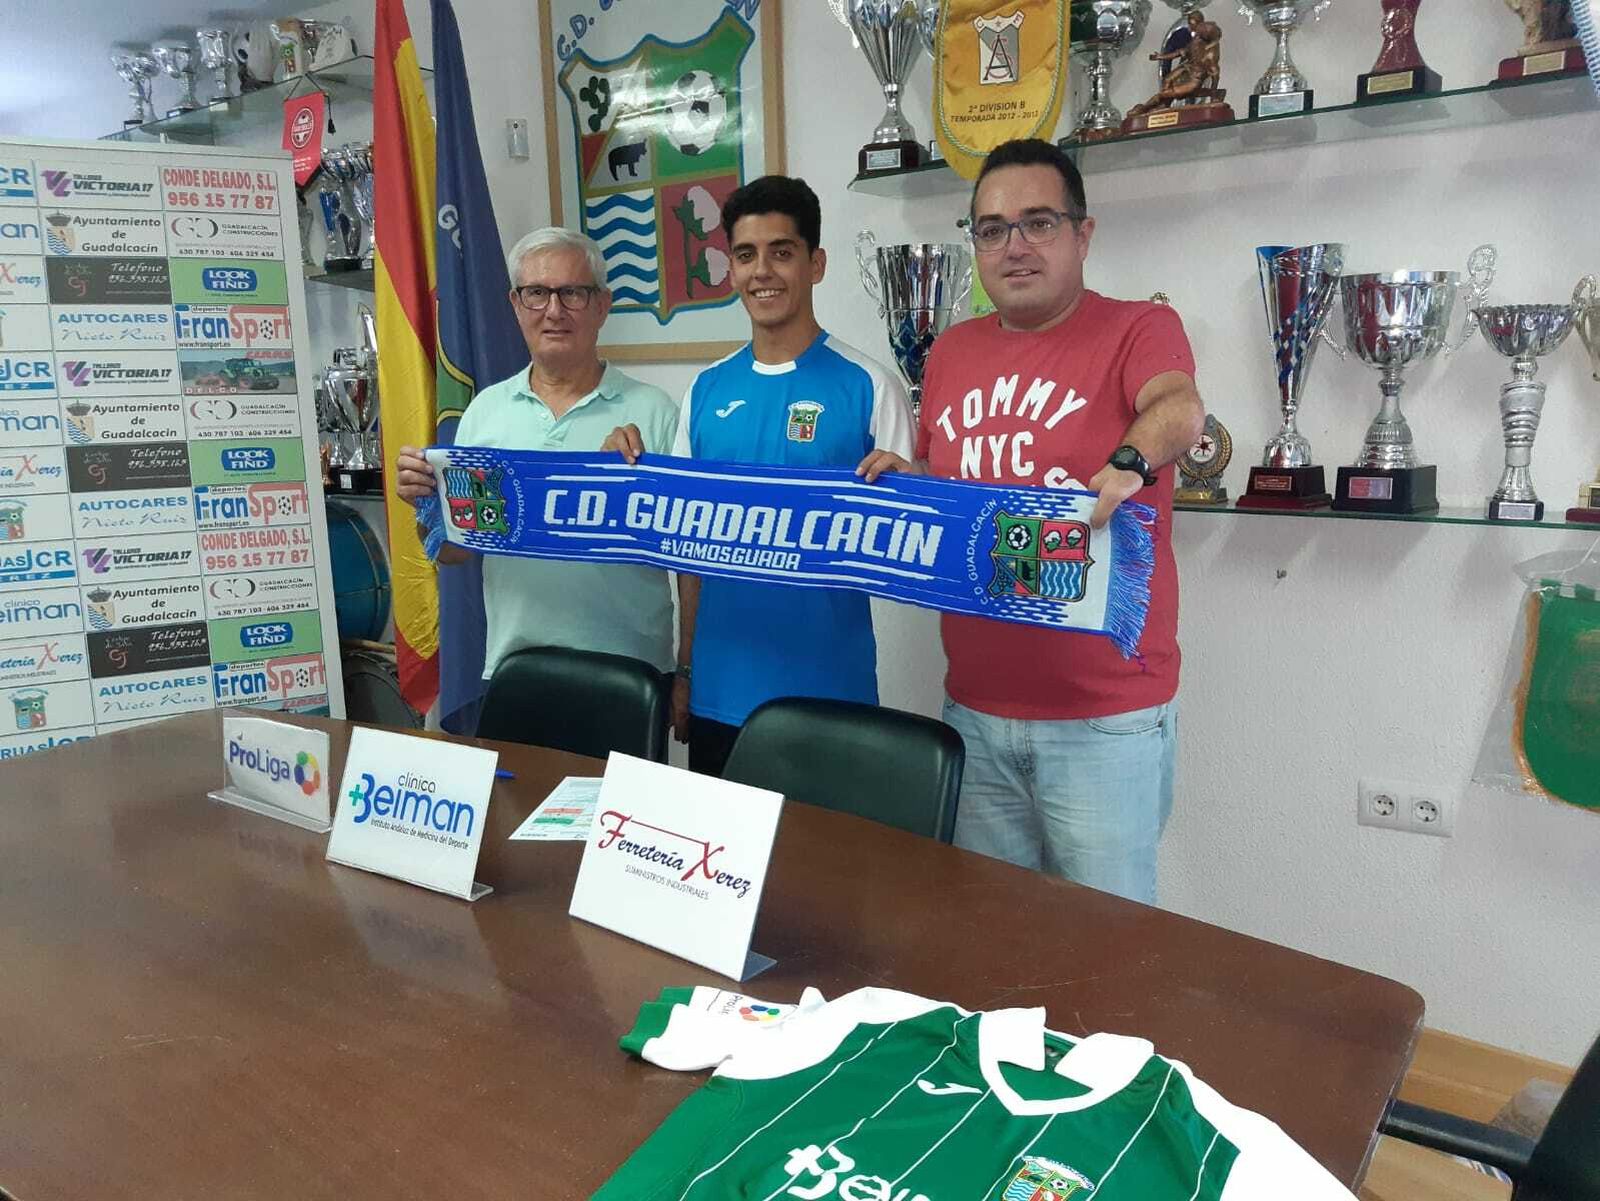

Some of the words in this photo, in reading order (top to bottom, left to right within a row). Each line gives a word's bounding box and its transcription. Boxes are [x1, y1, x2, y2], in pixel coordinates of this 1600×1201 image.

[979, 101, 1017, 113] DIVISION
[1020, 101, 1026, 109] B
[951, 113, 995, 123] TEMPORADA
[163, 169, 200, 187] CONDE
[168, 191, 199, 207] 956
[205, 193, 226, 208] 15
[230, 194, 249, 208] 77
[255, 195, 274, 209] 87
[73, 215, 161, 227] Ayuntamiento
[112, 230, 126, 239] de
[209, 269, 250, 279] LOOK
[213, 280, 249, 289] FIND
[58, 313, 168, 323] AUTOCARES
[92, 402, 180, 415] Ayuntamiento
[936, 374, 1087, 442] TOMMY
[131, 416, 146, 425] de
[227, 450, 269, 459] LOOK
[960, 430, 1034, 480] NYC
[231, 460, 268, 469] FIND
[78, 496, 188, 511] AUTOCARES
[544, 489, 617, 527] C.D.
[626, 492, 944, 567] GUADALCACÍN
[201, 532, 237, 551] CONDE
[206, 555, 237, 570] 956
[242, 553, 262, 566] 15
[266, 551, 285, 565] 77
[291, 549, 308, 563] 87
[660, 538, 801, 570] #VAMOSGUADA
[113, 584, 200, 599] Ayuntamiento
[151, 599, 166, 608] de
[247, 624, 287, 636] LOOK
[250, 635, 285, 646] FIND
[99, 675, 208, 697] AUTOCARES
[229, 740, 290, 782] ProLiga
[354, 773, 474, 837] Beiman
[417, 830, 438, 842] Medicina
[439, 835, 448, 845] del
[448, 836, 469, 850] Deporte
[597, 810, 685, 871] Ferretería
[681, 841, 752, 898] Xerez
[624, 864, 665, 885] SUMINISTROS
[666, 878, 710, 900] INDUSTRIALES
